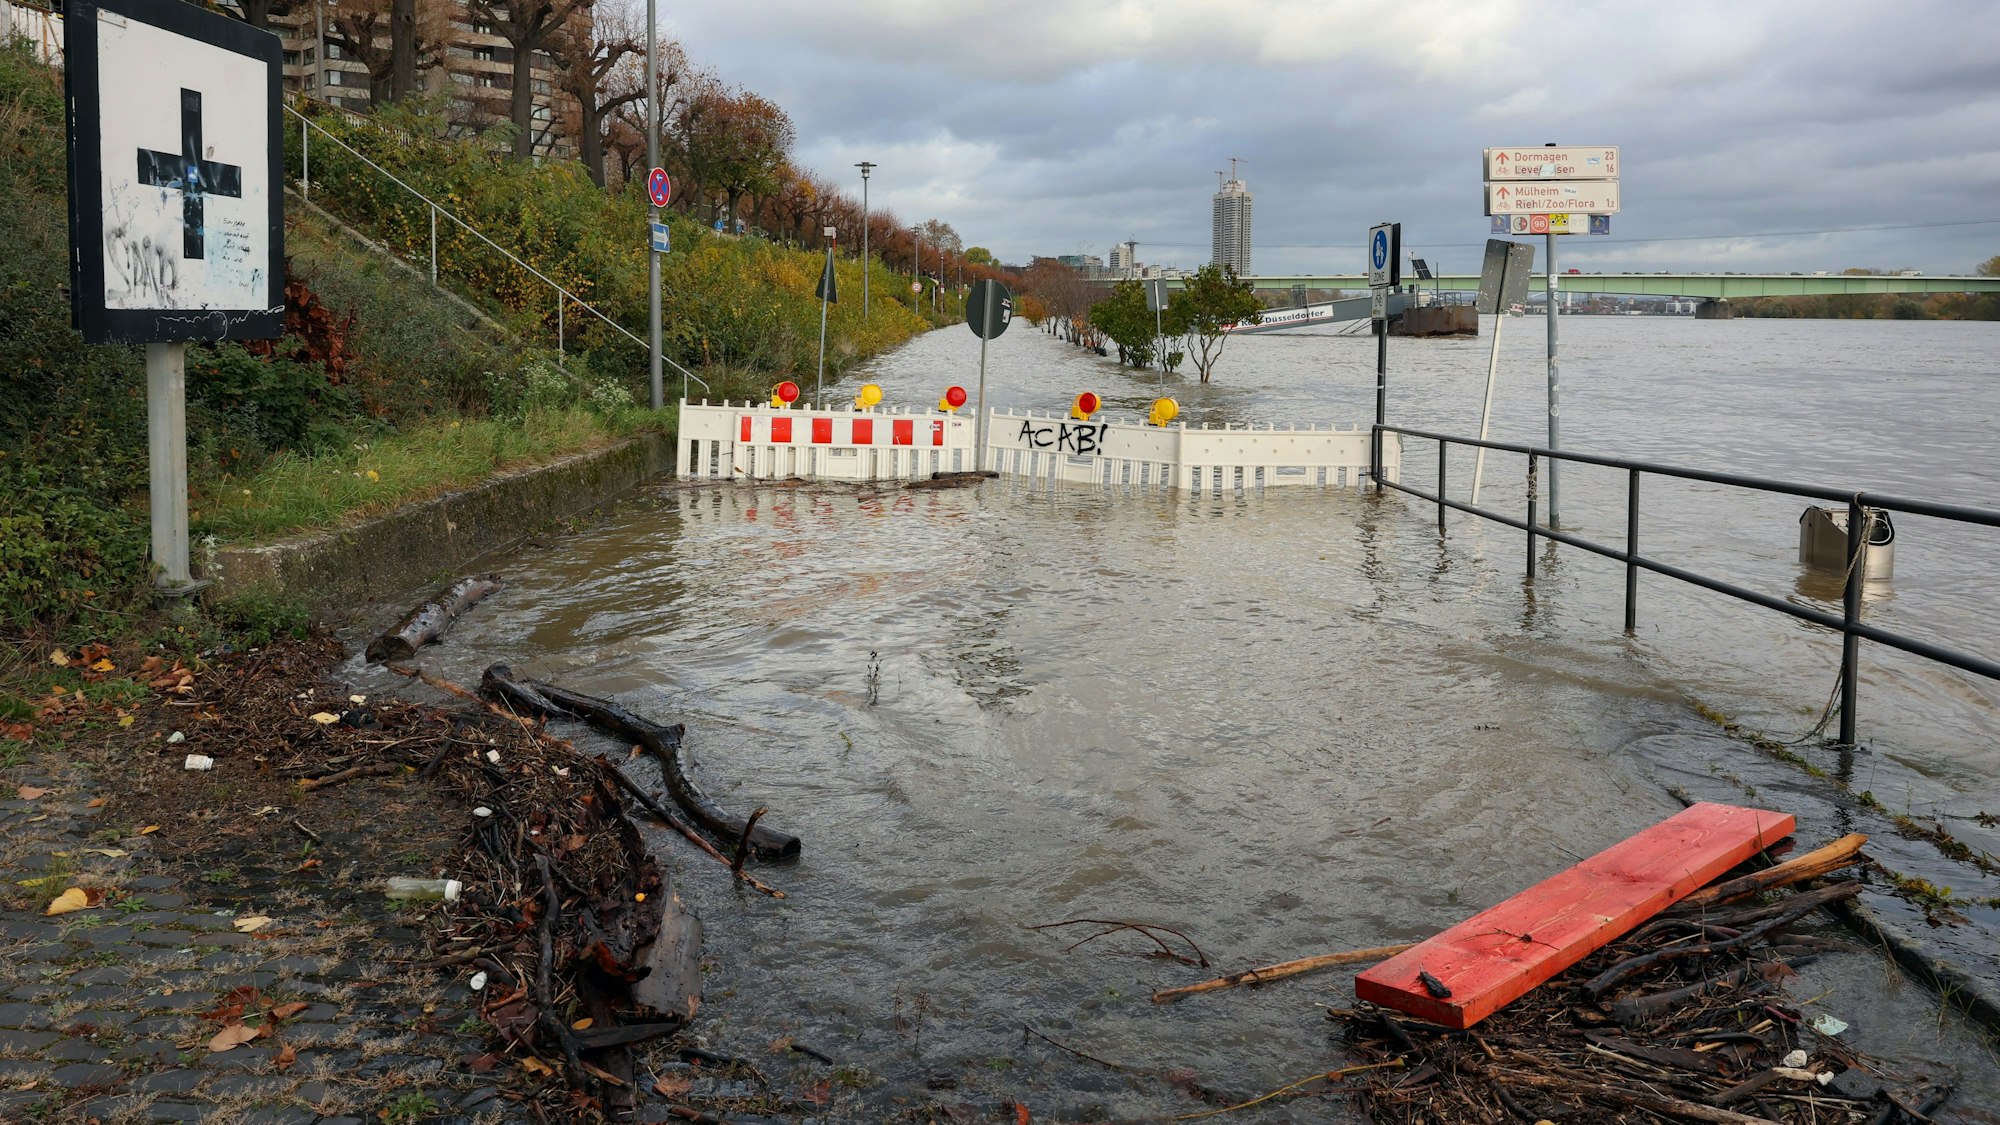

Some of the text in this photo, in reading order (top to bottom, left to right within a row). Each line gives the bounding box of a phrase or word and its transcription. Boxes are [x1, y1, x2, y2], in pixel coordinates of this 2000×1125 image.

[1514, 151, 1615, 163] Dormagen 23
[1514, 164, 1615, 174] Levesen 16
[1515, 187, 1559, 196] Mülheim
[1515, 199, 1595, 209] Riehl/Zoo/Flora
[1534, 220, 1545, 228] 98
[1373, 271, 1385, 282] ZONE
[1018, 420, 1108, 456] ACAB!
